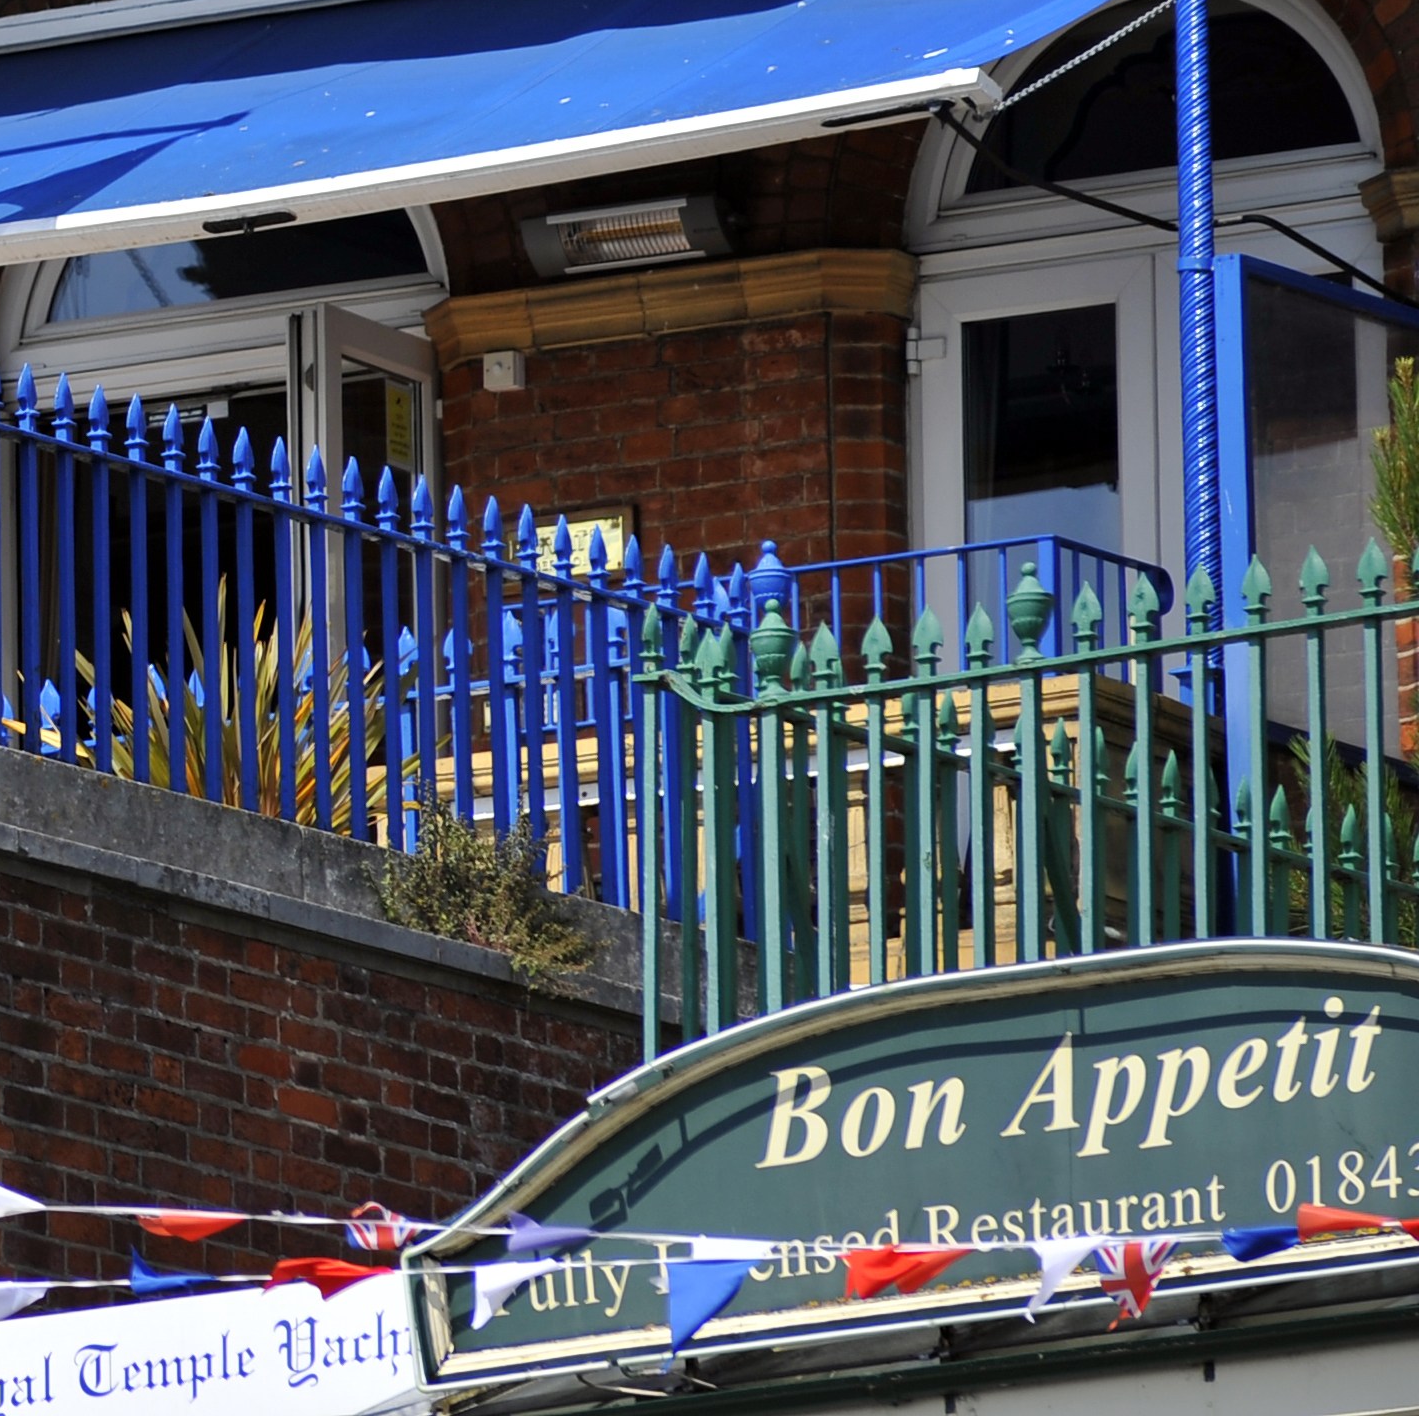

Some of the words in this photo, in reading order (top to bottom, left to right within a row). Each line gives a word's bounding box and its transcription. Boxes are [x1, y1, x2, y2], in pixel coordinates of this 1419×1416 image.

[755, 1065, 967, 1169] Bon
[1000, 996, 1383, 1158] Appetit
[493, 1248, 631, 1317] ully
[922, 1175, 1226, 1253] Restaurant
[74, 1343, 255, 1404] Temple
